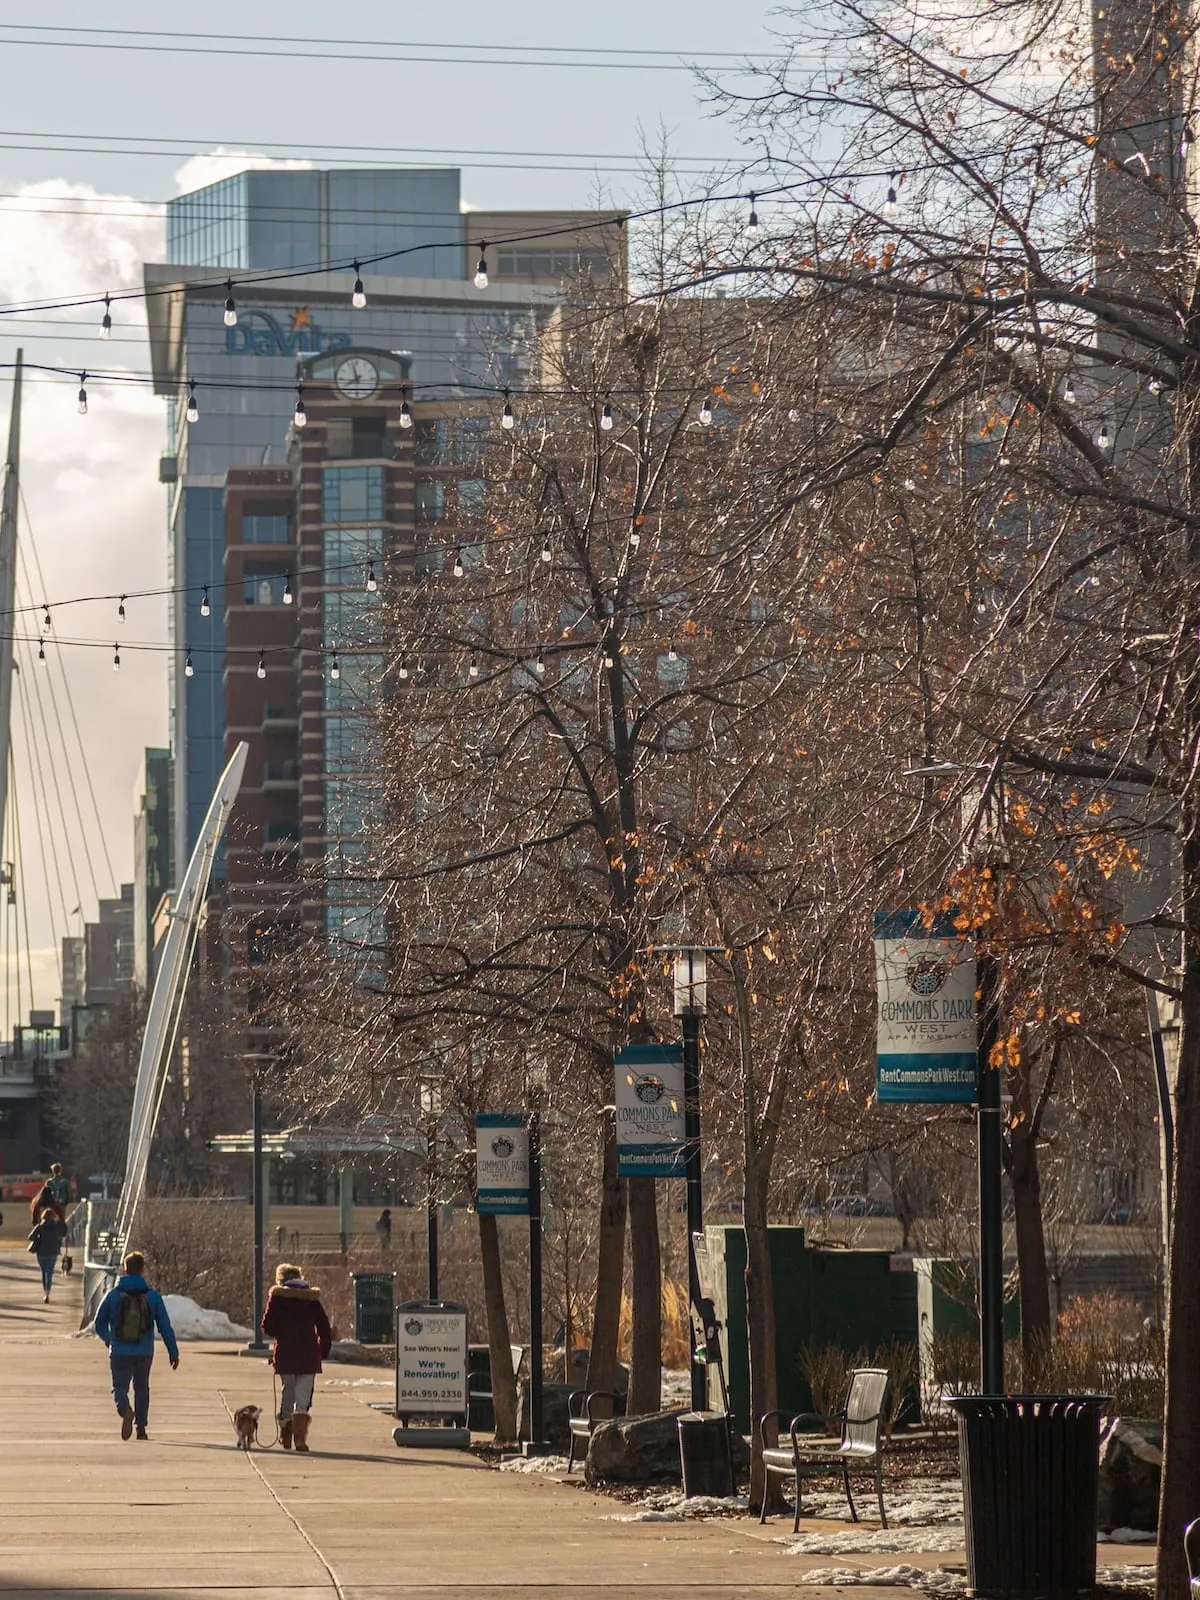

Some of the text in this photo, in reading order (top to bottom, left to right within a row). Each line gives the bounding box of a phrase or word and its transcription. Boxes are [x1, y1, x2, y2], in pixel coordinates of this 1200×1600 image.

[226, 310, 353, 356] DaVita
[881, 1000, 972, 1021] COMMONS PARK
[905, 1024, 948, 1033] WEST
[880, 1068, 975, 1082] RentCommonsParkWest.com
[618, 1106, 683, 1122] COMMONS PARK
[636, 1123, 666, 1131] WEST
[478, 1160, 511, 1171] COMMONS
[419, 1360, 445, 1369] We're
[404, 1370, 460, 1380] Renovating!
[401, 1389, 462, 1398] 844.959.2338
